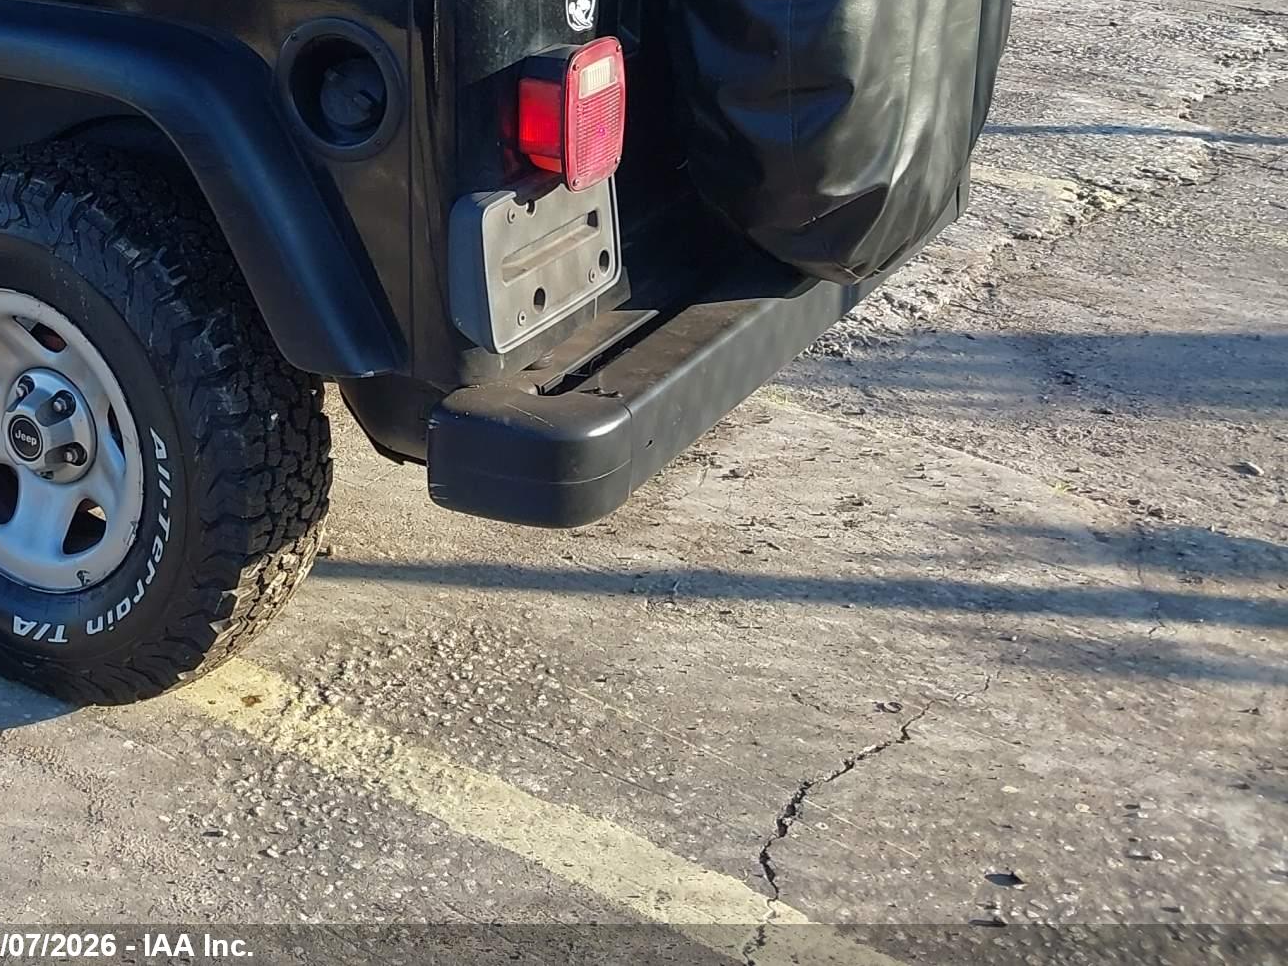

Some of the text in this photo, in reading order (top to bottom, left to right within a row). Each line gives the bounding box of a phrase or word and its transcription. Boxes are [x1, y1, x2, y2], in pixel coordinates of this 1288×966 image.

[14, 430, 38, 447] Jeep
[13, 427, 172, 643] All-Terrain T/A
